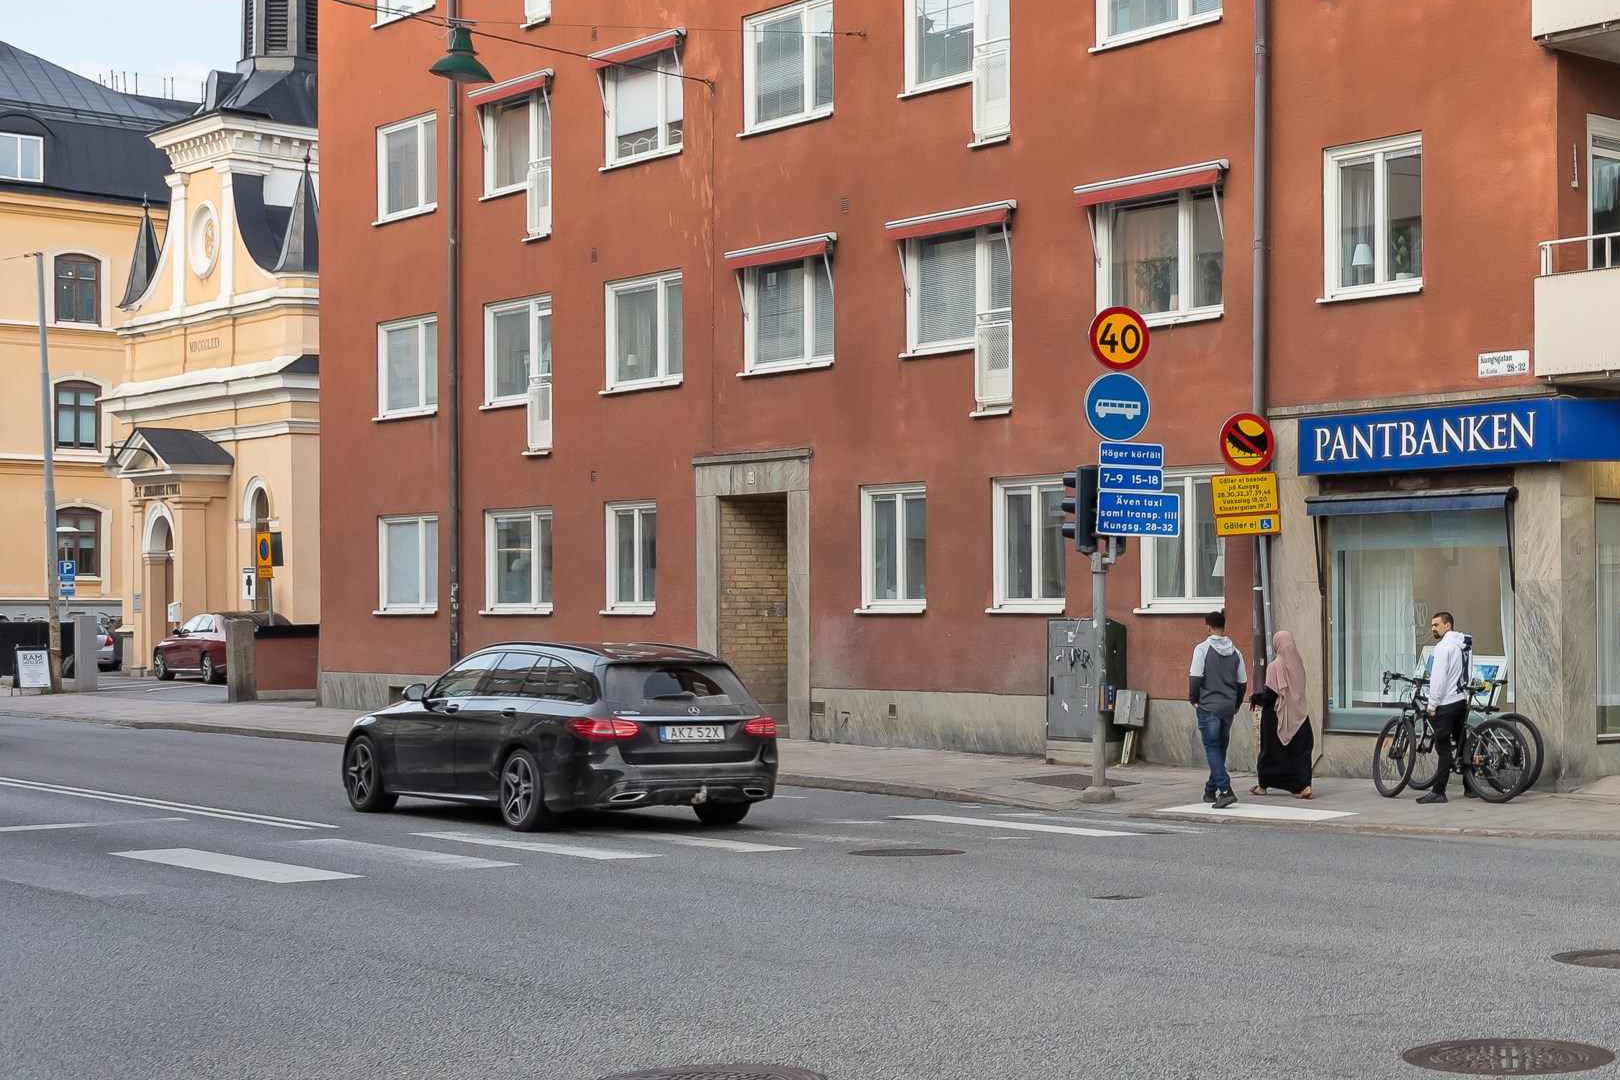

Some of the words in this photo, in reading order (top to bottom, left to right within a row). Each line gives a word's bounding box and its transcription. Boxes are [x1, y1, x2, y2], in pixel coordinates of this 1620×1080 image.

[1099, 323, 1140, 354] 40
[1481, 355, 1512, 365] Kungsgatan
[1506, 362, 1526, 372] 28-32
[1314, 411, 1536, 462] PANTBANKEN
[1102, 449, 1128, 458] Höger
[1131, 450, 1160, 459] körfält
[1103, 473, 1123, 484] 7-9
[1132, 474, 1158, 485] 15-18
[1116, 495, 1140, 506] Även
[1144, 498, 1162, 507] taxi
[1100, 510, 1124, 518] samt
[1127, 510, 1160, 520] transp.
[1164, 512, 1177, 520] till
[1103, 521, 1142, 532] Kungsg.
[1145, 523, 1173, 532] 28-32
[1224, 522, 1246, 530] Gäller
[1250, 521, 1256, 530] ej
[63, 562, 72, 574] P
[671, 727, 694, 738] AKZ
[697, 727, 720, 738] 52X
